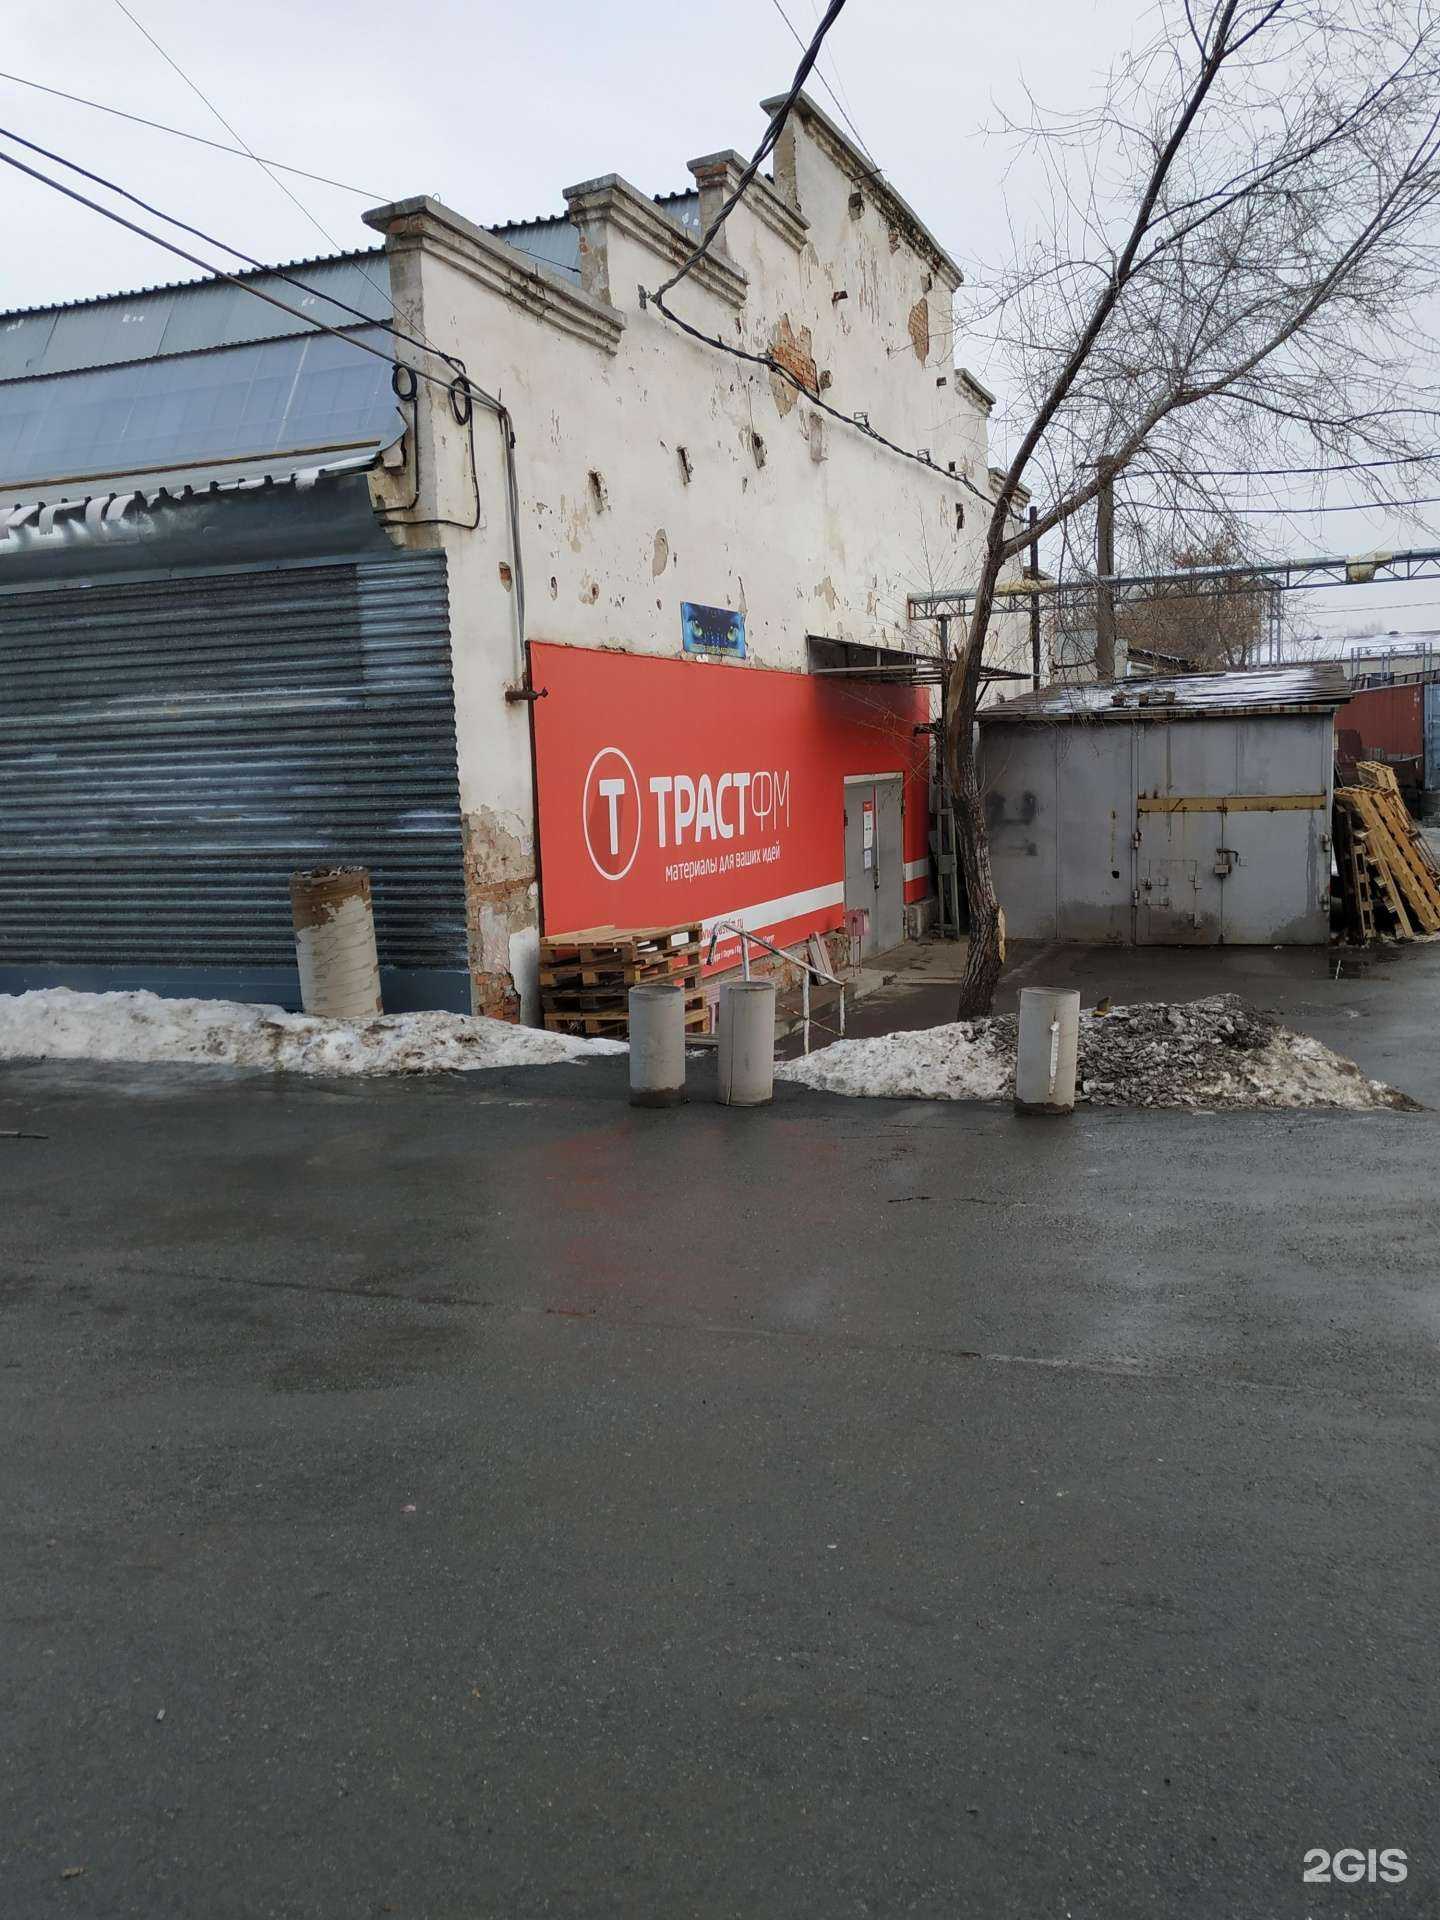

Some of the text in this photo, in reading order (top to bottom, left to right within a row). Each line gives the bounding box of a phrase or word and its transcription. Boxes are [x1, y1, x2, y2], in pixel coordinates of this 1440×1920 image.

[599, 778, 625, 855] Т
[649, 770, 790, 848] ТРАСТФМ
[665, 840, 781, 882] материалы для ваших идей
